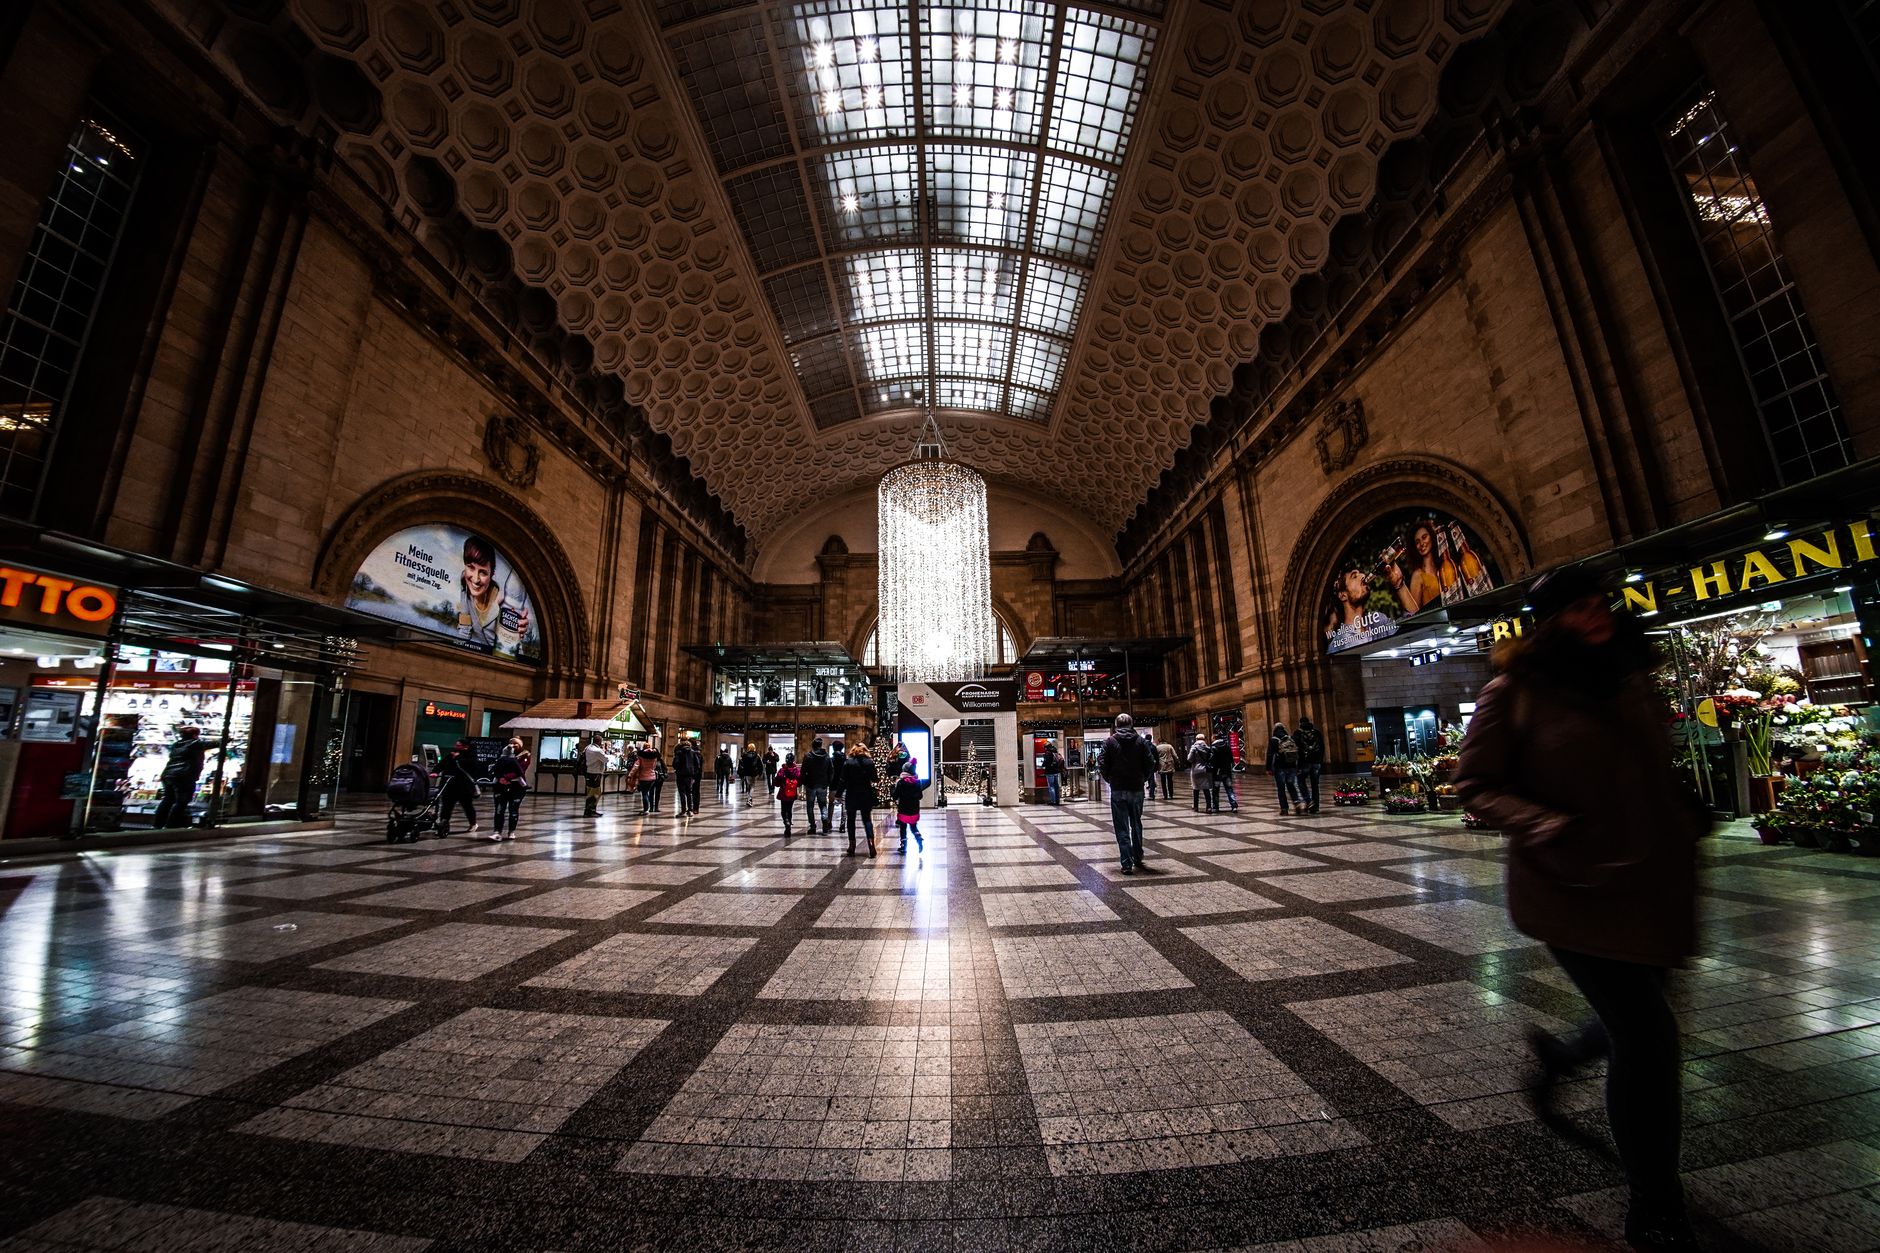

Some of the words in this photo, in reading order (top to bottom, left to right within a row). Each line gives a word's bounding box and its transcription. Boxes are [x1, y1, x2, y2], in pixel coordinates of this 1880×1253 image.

[408, 544, 433, 563] Meine
[394, 551, 451, 584] Fitnessquelle,
[407, 572, 416, 580] mit
[415, 575, 431, 585] jedem
[1325, 630, 1336, 640] Wo
[1337, 622, 1354, 635] alles
[1353, 611, 1381, 629] Gute
[815, 667, 830, 676] SUPER
[829, 667, 838, 676] CUT
[912, 695, 925, 705] DB
[961, 701, 1000, 709] Willkommen
[436, 709, 466, 718] Sparkasse
